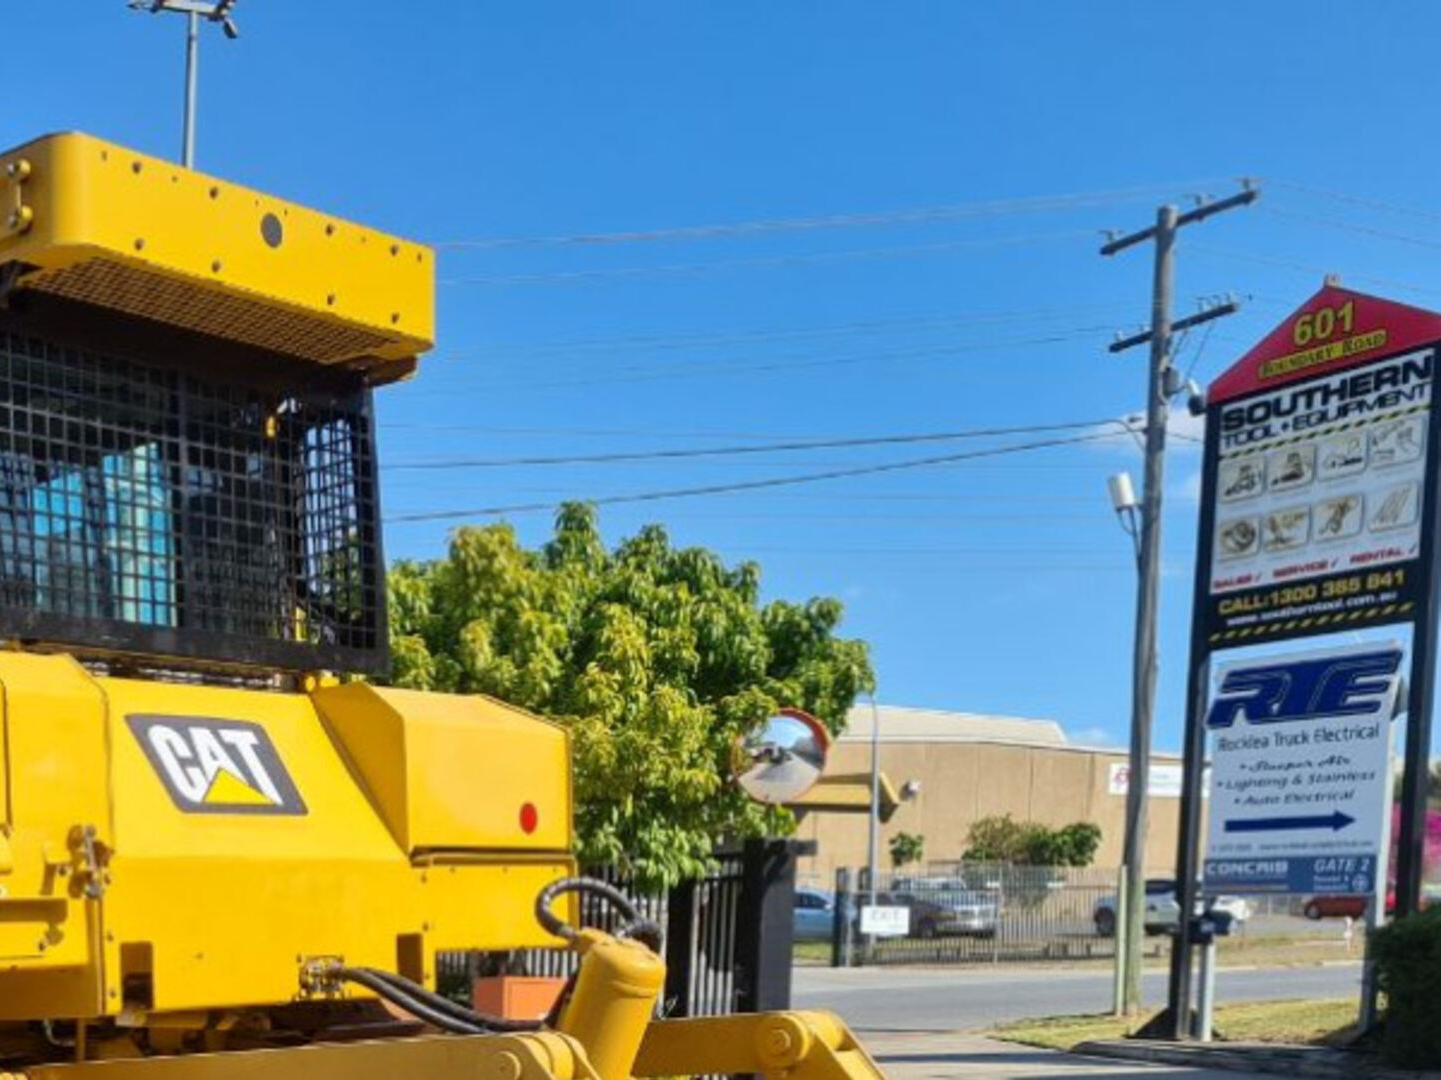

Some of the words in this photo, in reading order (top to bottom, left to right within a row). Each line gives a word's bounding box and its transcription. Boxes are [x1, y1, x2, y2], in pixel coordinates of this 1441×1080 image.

[1293, 299, 1355, 347] 601
[1222, 355, 1434, 431] SOUTHERN
[1349, 549, 1404, 564] RENTAL
[1274, 730, 1309, 748] Truck
[1313, 722, 1380, 744] Electrical
[147, 724, 284, 806] CAT
[1313, 857, 1355, 873] GATE
[1360, 857, 1370, 872] 2
